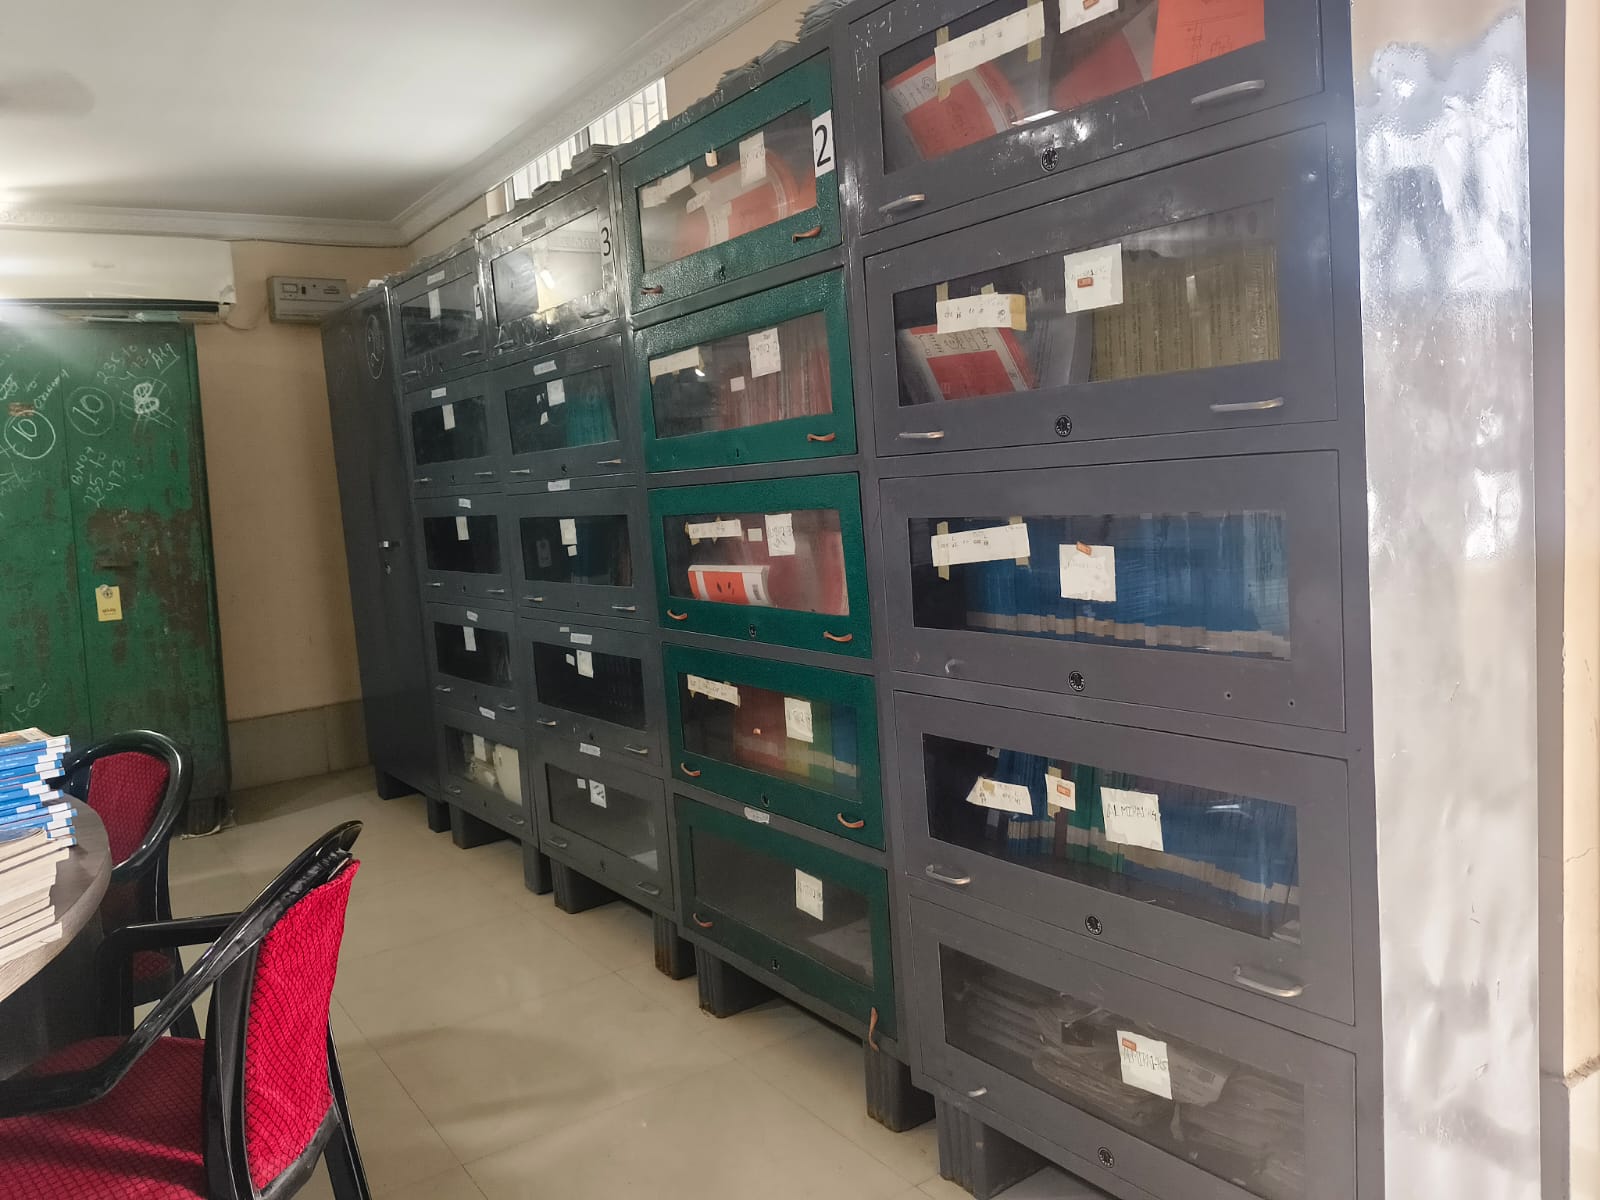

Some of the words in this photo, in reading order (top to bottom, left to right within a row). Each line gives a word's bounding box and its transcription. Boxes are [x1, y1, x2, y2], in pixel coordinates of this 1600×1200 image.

[815, 124, 831, 168] 2
[600, 226, 611, 257] 3
[72, 394, 104, 425] 10
